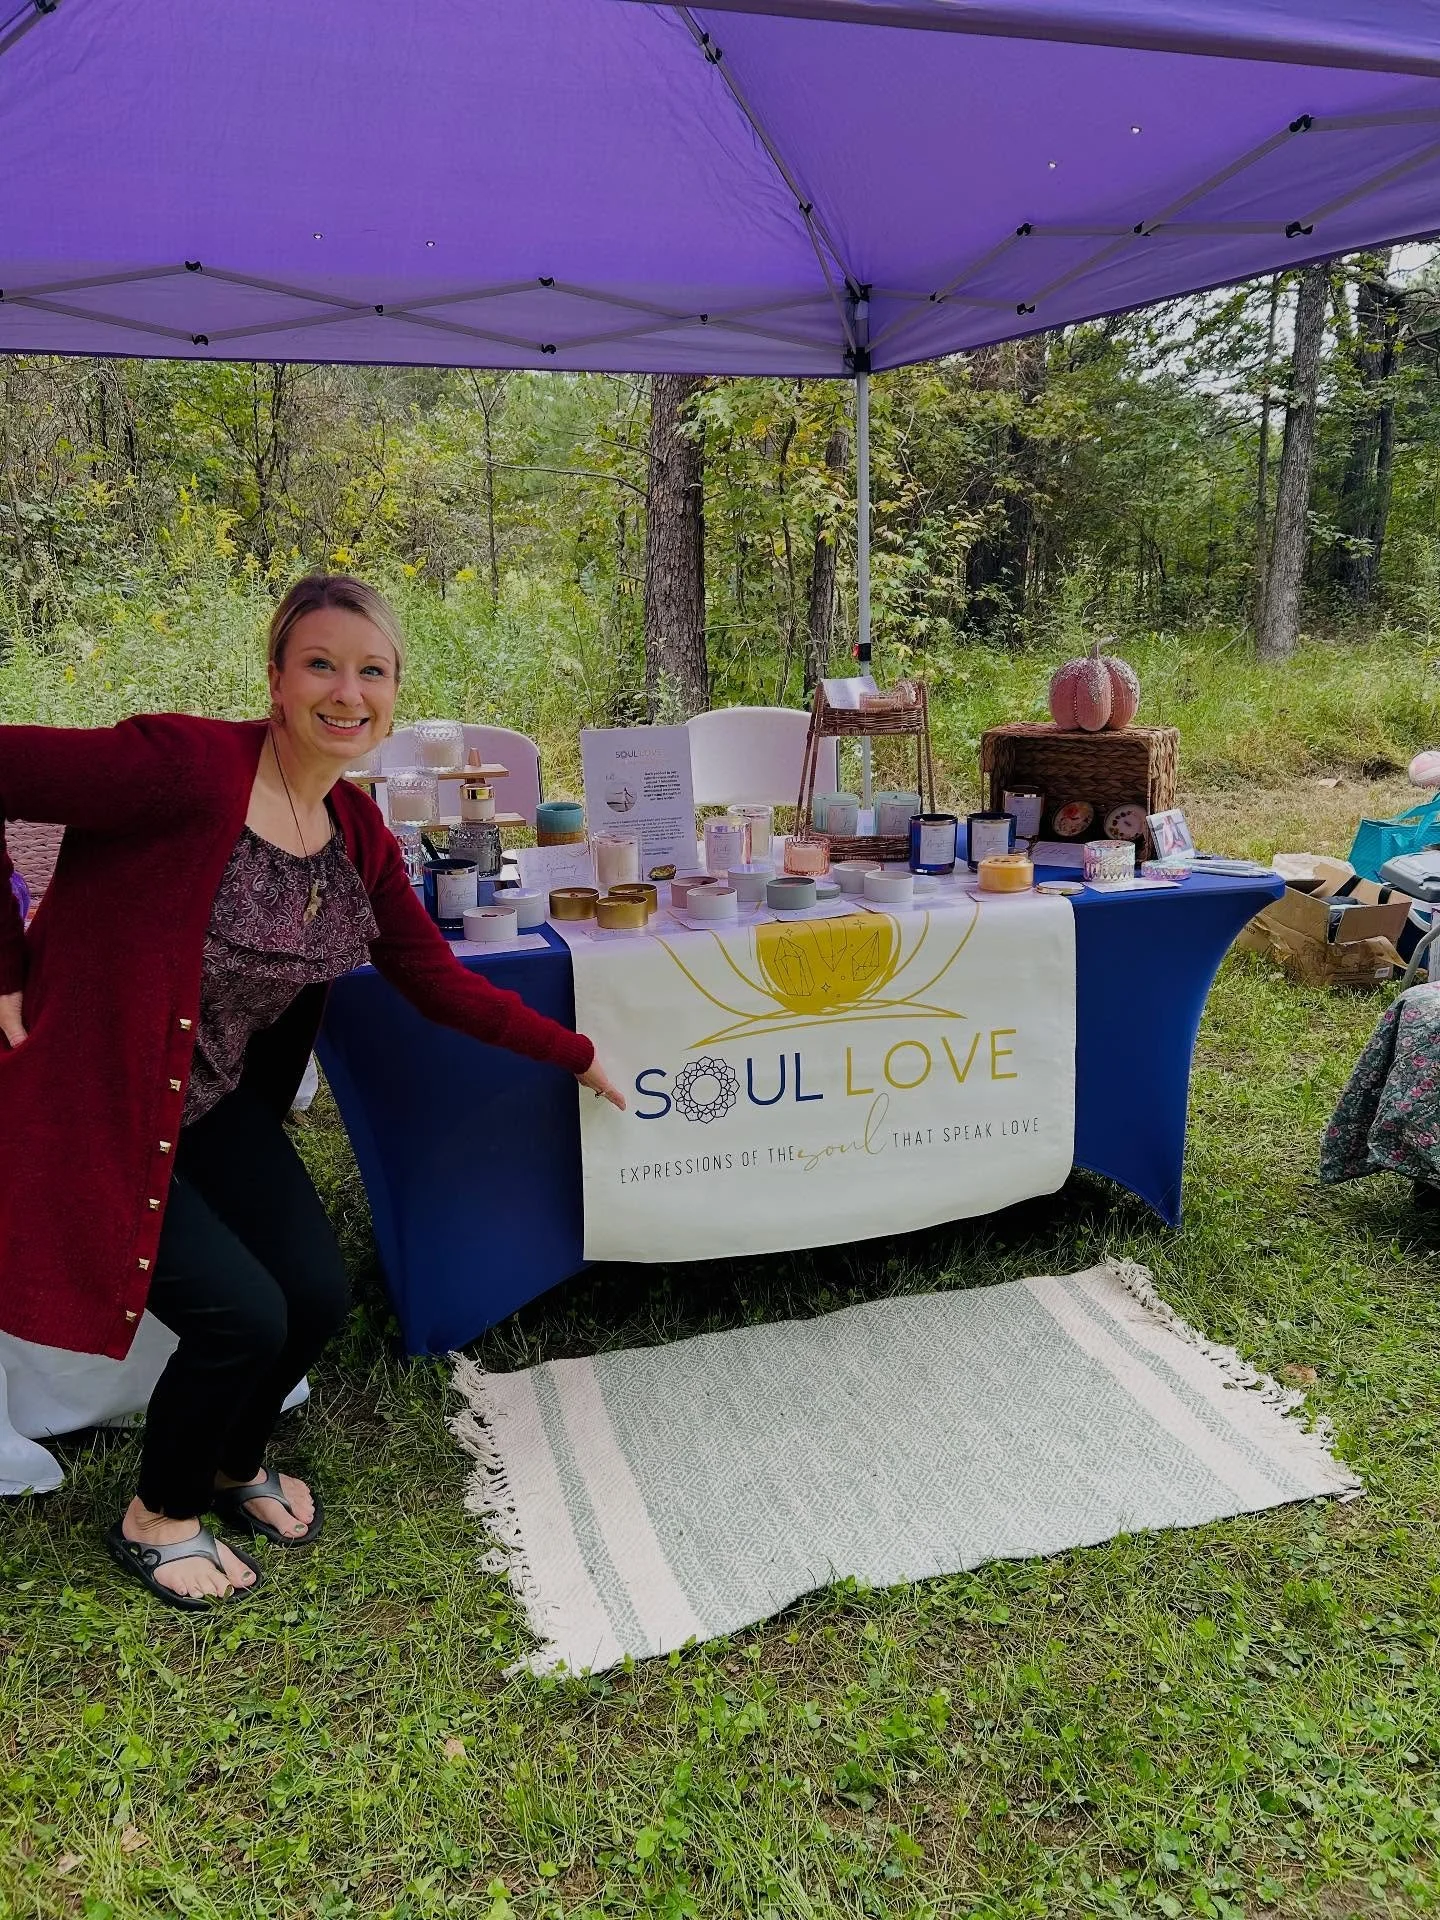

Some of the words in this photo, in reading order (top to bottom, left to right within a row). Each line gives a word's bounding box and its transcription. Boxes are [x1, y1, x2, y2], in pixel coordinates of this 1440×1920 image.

[635, 1053, 824, 1124] SOUL
[846, 1029, 1018, 1096] LOVE
[620, 1153, 733, 1184] EXPRESSIONS
[742, 1149, 758, 1167] OF
[768, 1145, 795, 1163] THE
[797, 1092, 890, 1172] soul
[892, 1129, 933, 1148] THAT
[943, 1122, 993, 1143] SPEAK
[1001, 1117, 1039, 1136] LOVE
